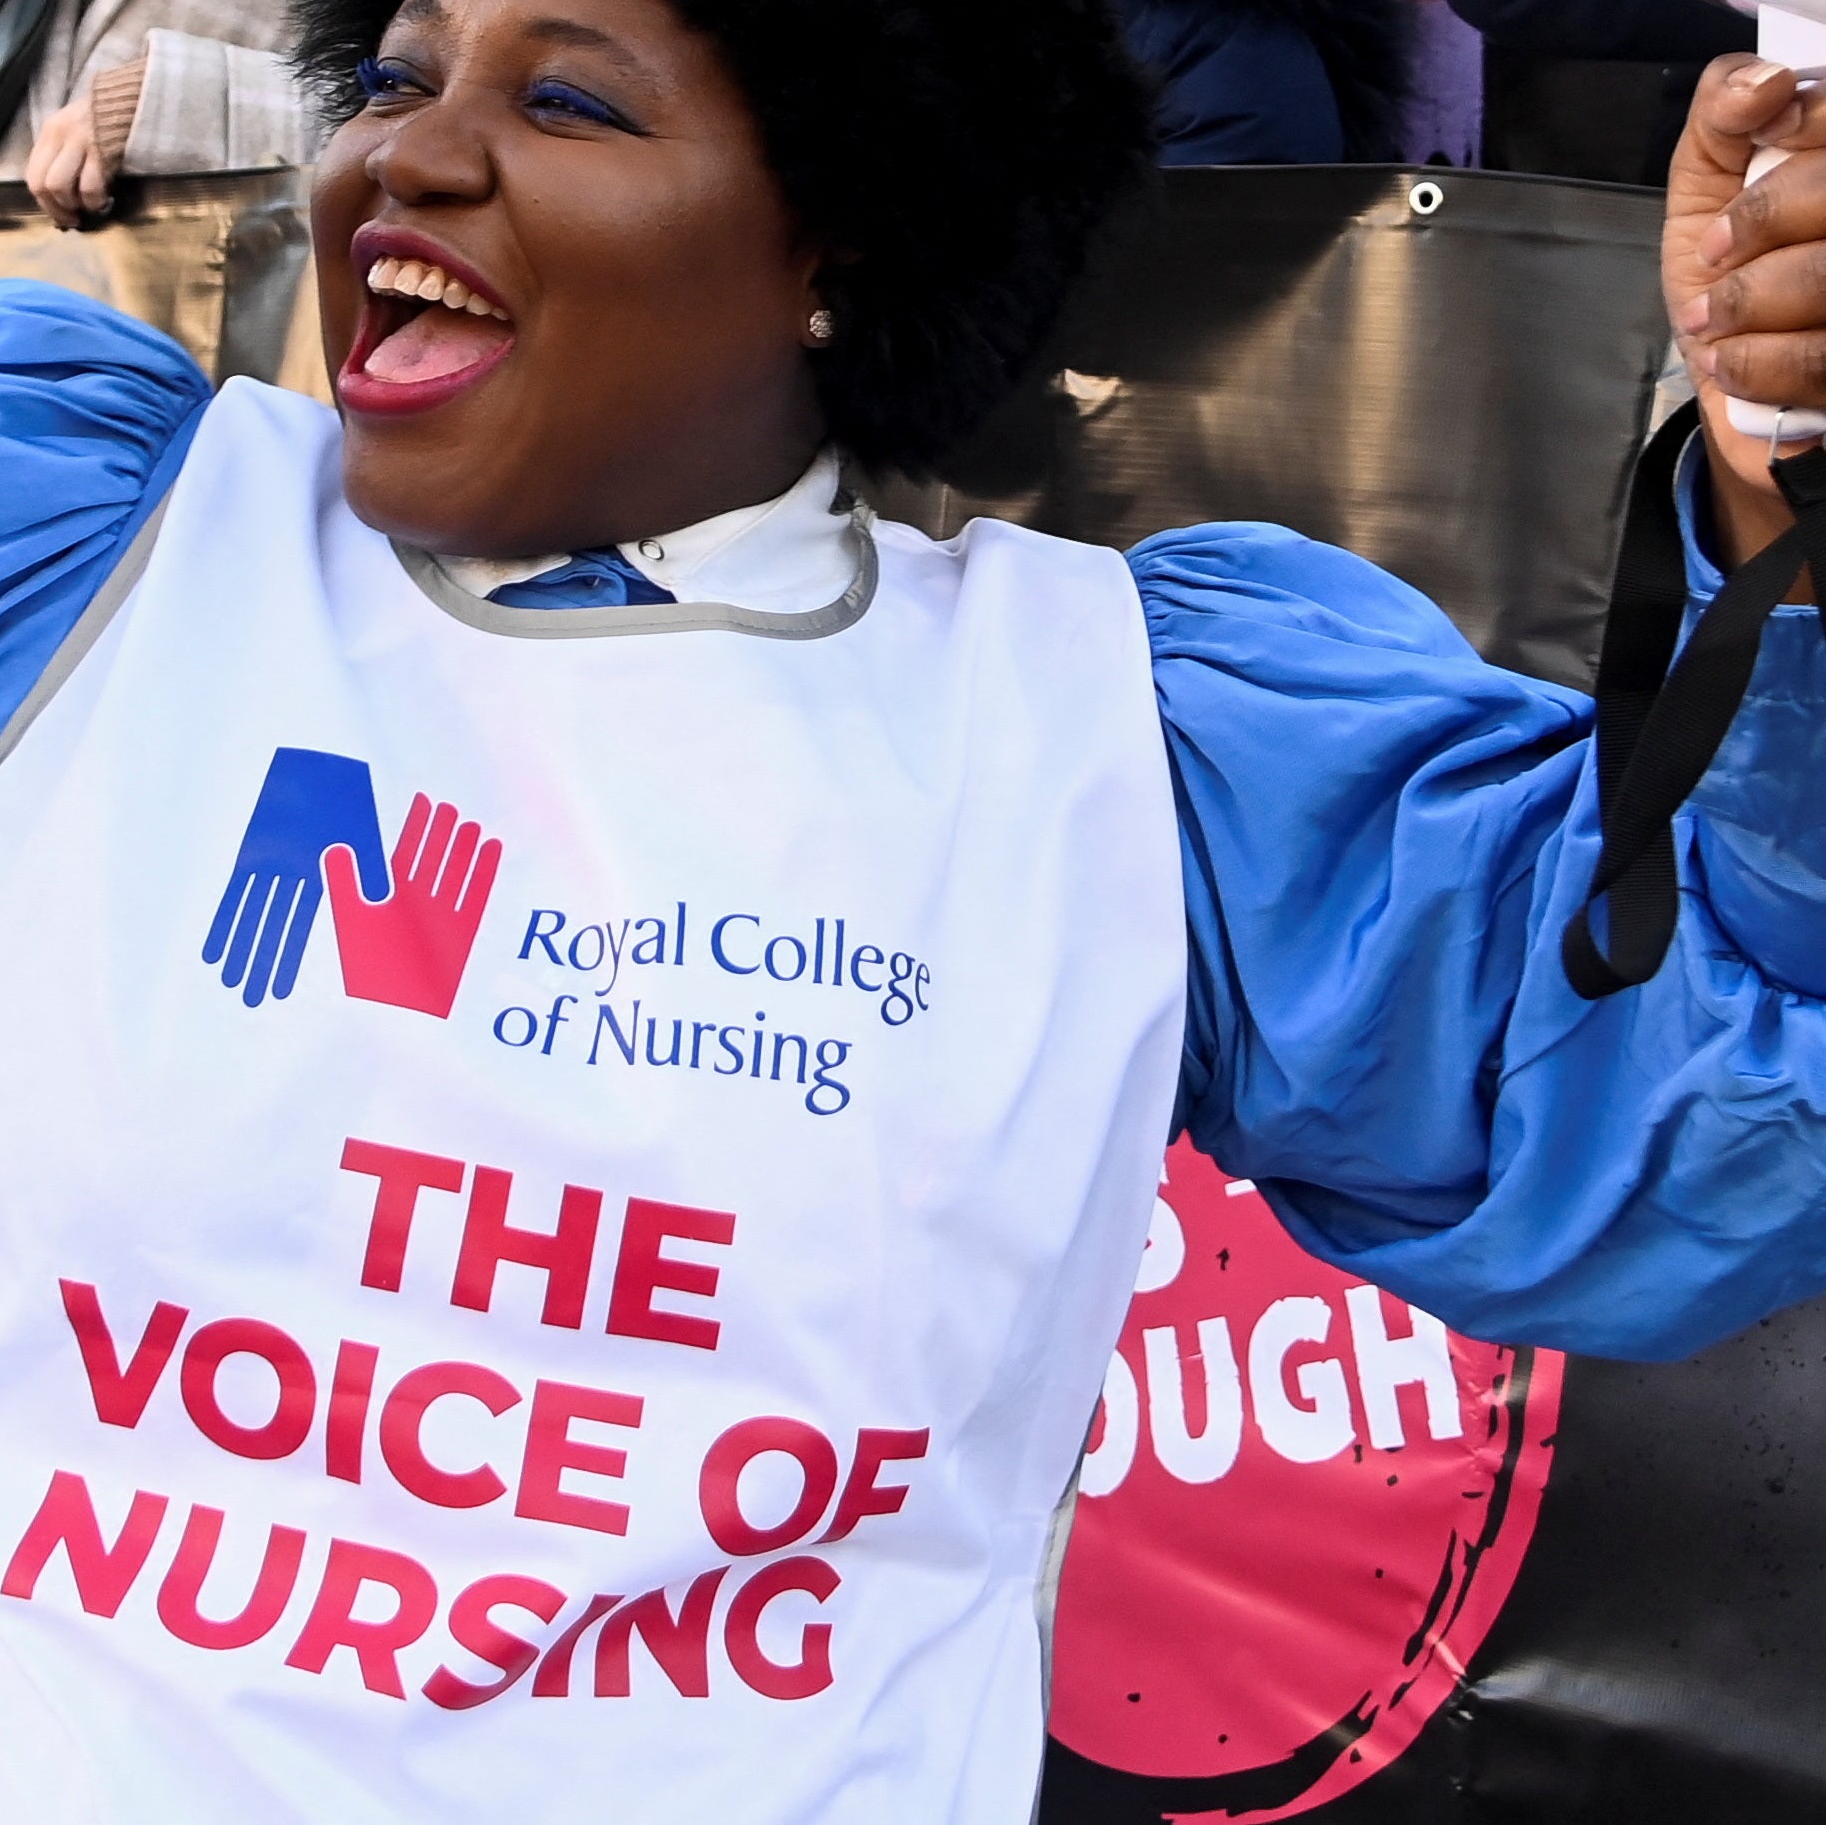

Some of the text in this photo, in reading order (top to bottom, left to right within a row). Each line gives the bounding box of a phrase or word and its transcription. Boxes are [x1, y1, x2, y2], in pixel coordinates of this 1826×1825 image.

[516, 901, 931, 1026] Royal College
[493, 994, 853, 1116] of Nursing
[339, 1136, 737, 1352] THE
[57, 1276, 931, 1558] VOICE OF
